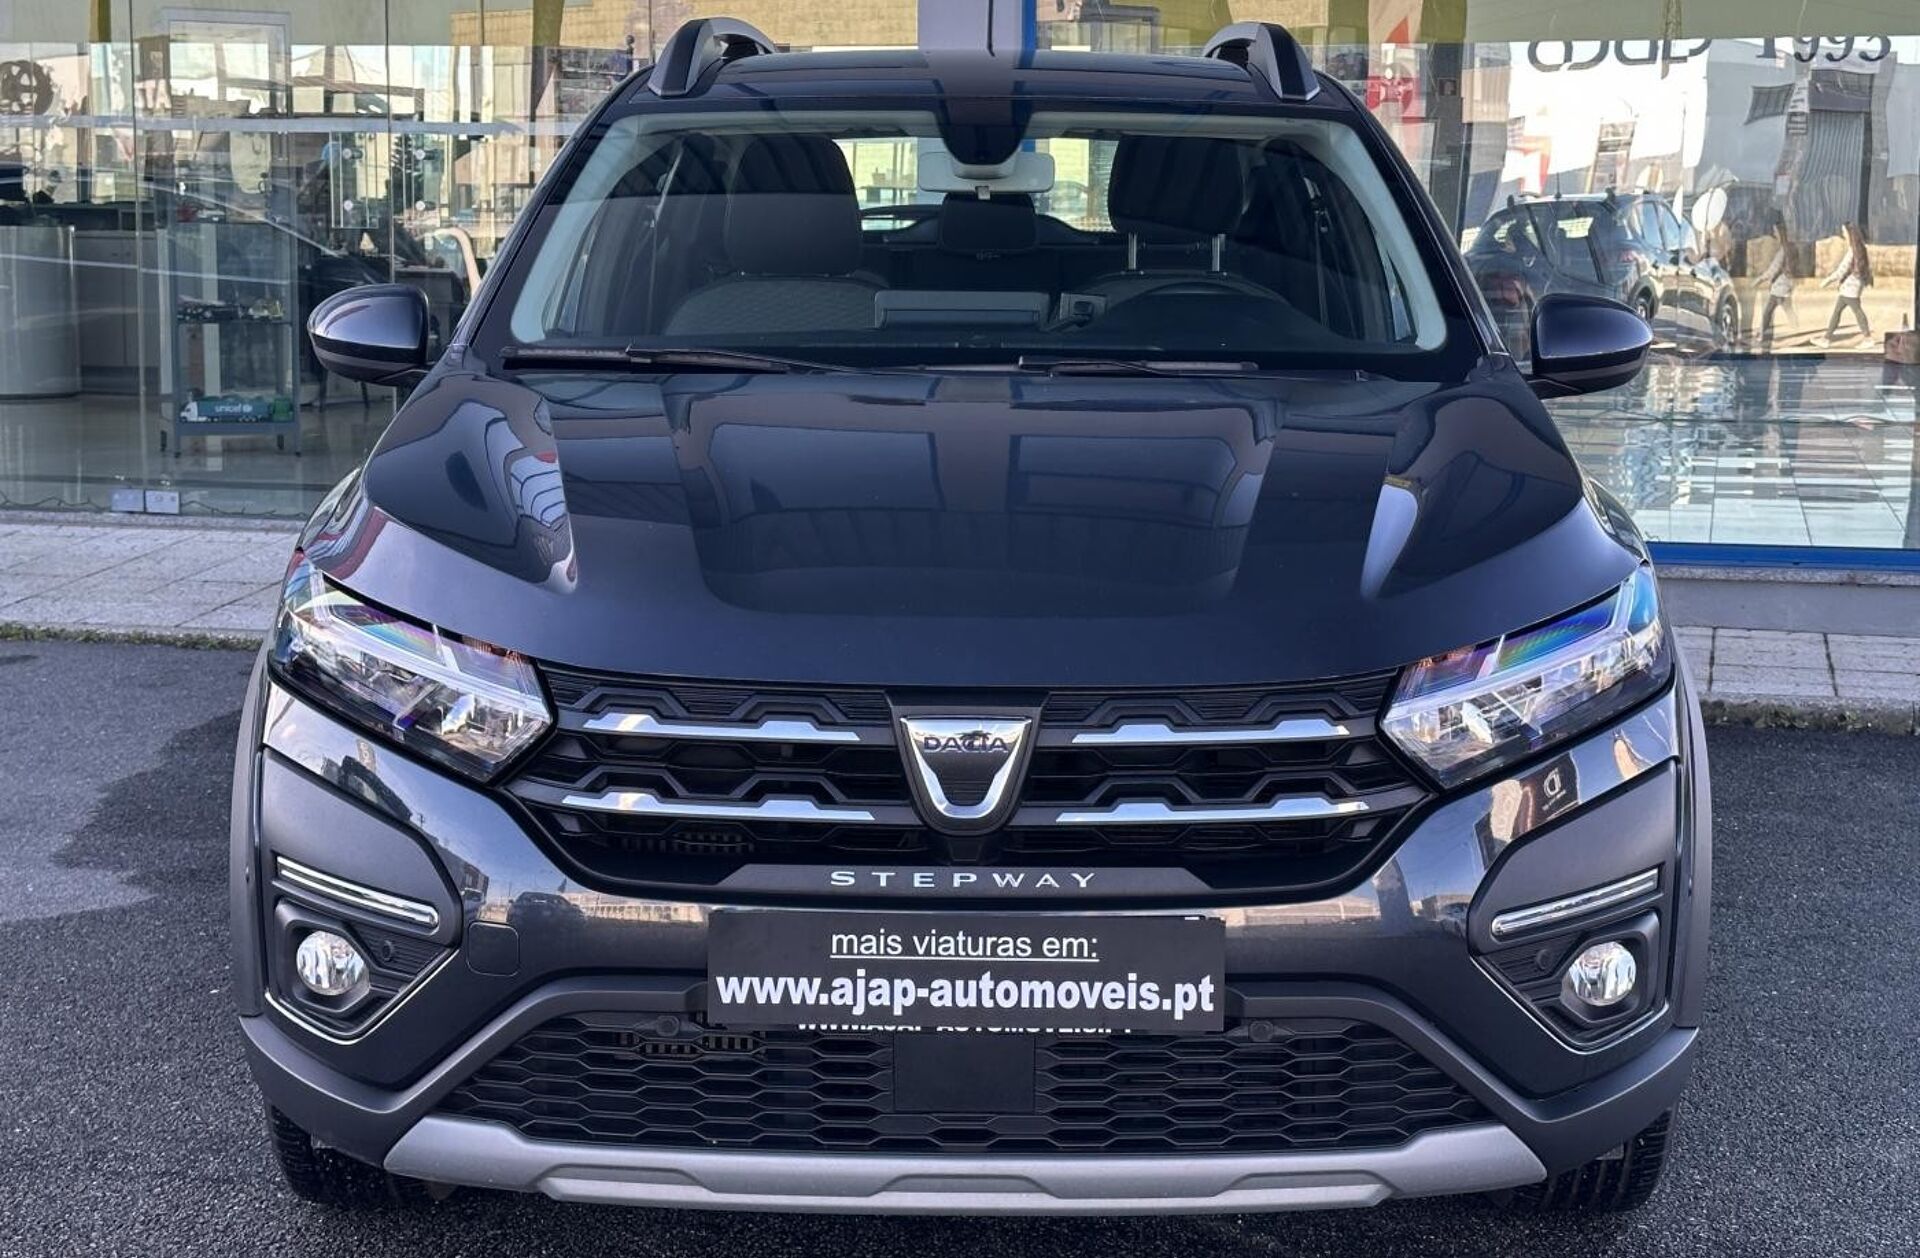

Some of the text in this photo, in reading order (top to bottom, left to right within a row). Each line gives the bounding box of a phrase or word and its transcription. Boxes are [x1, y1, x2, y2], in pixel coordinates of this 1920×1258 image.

[923, 736, 1009, 752] DACIA
[829, 870, 1097, 889] STEPWAY
[832, 929, 1099, 958] mais viaturas em:
[716, 969, 1216, 1019] www.ajap-automoveis.pt
